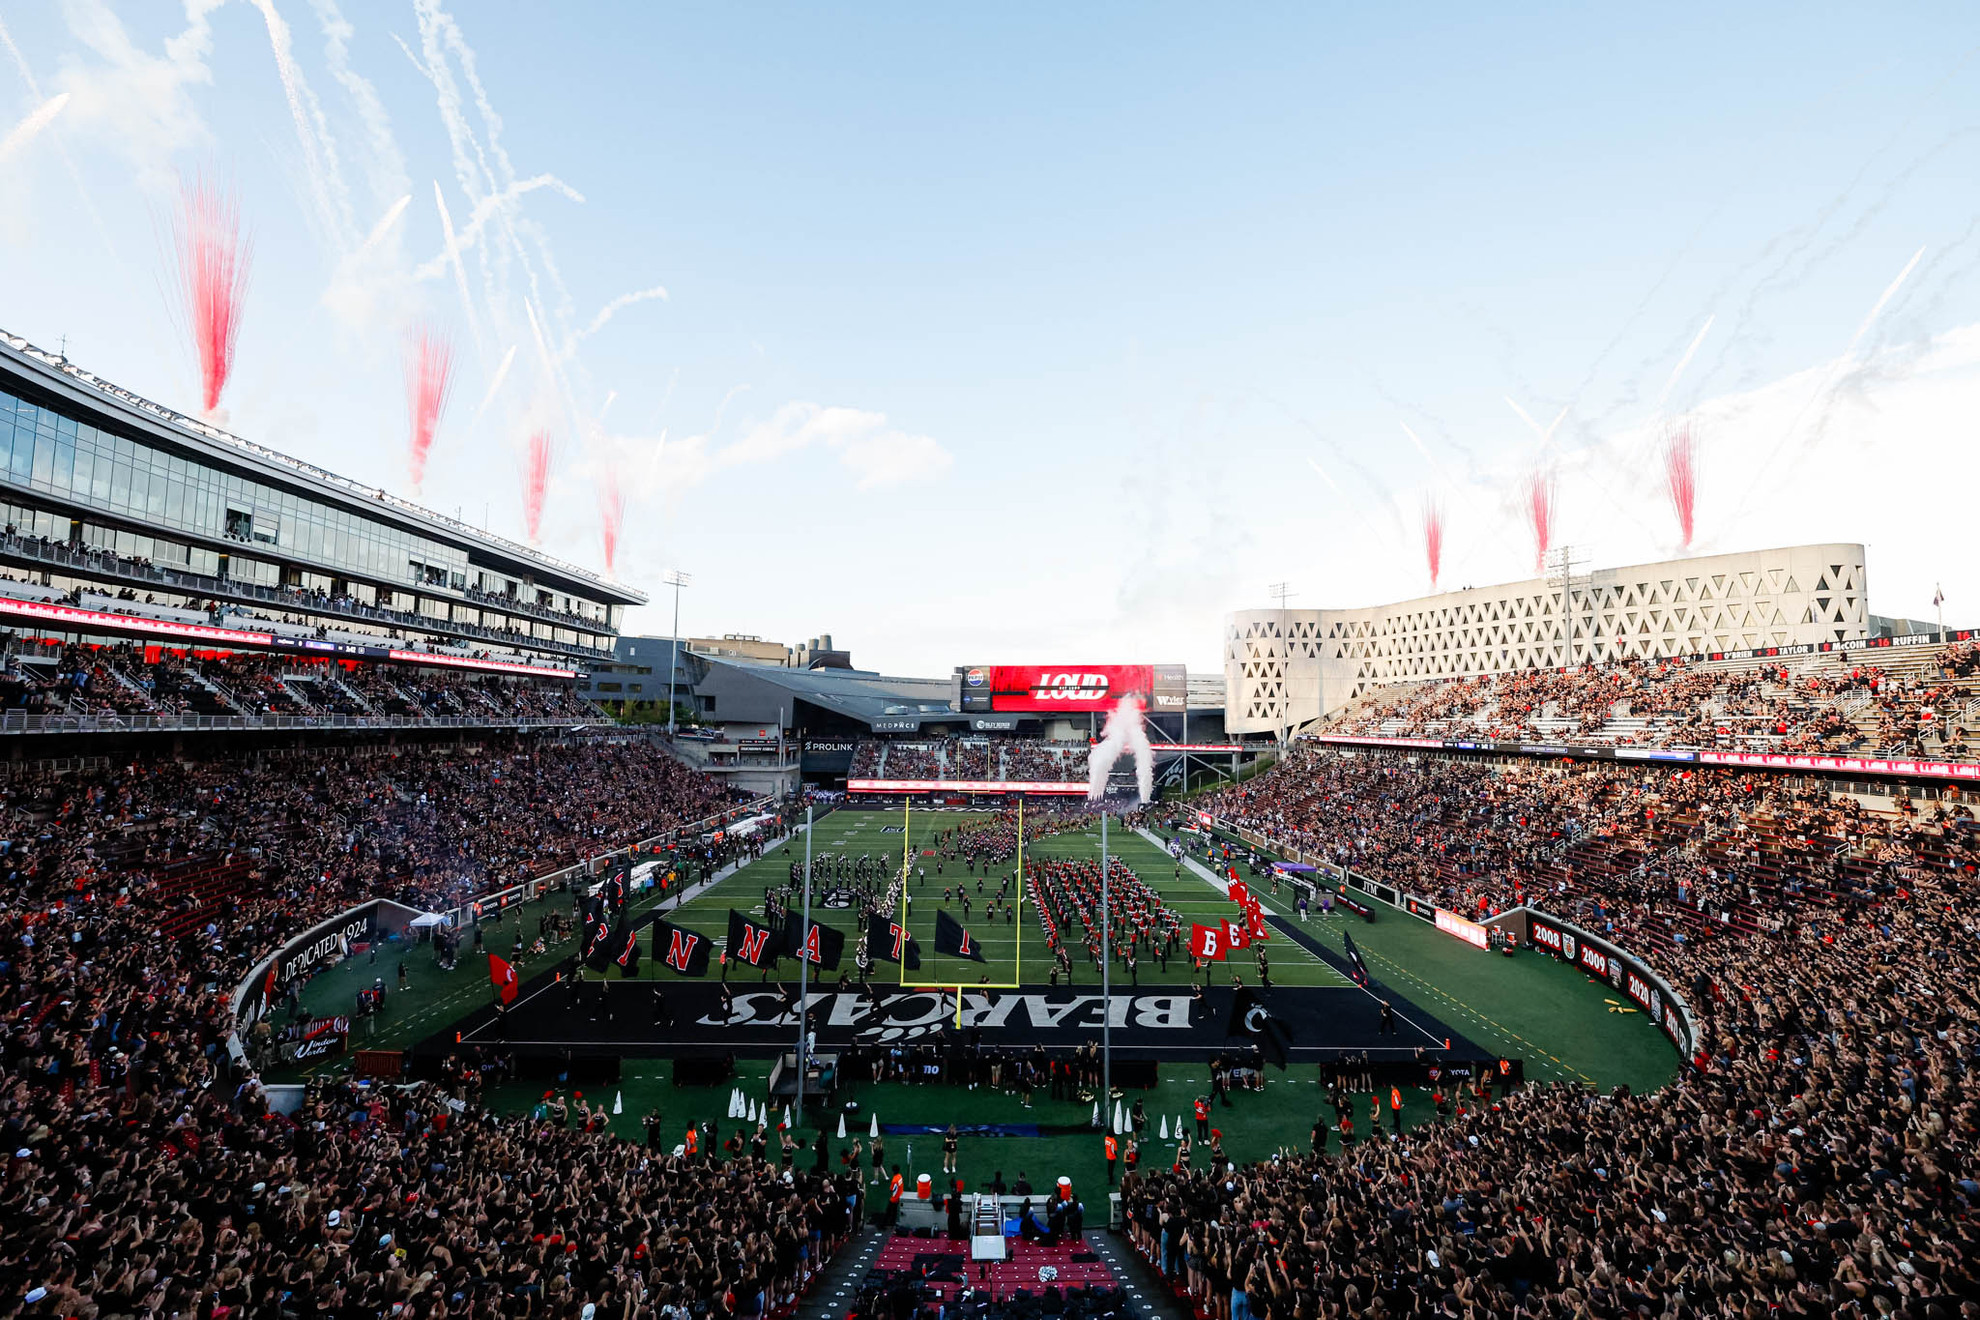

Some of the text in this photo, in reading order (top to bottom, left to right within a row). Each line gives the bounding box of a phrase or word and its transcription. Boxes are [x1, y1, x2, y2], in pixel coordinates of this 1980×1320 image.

[1724, 650, 1753, 659] O'BRIEN
[1779, 646, 1808, 655] TAYLOR
[1832, 640, 1867, 651] McCOIN
[1892, 634, 1930, 646] RUFFIN
[1035, 673, 1109, 700] LOUD
[812, 743, 853, 751] PROLINK
[1362, 880, 1378, 896] JTM
[482, 901, 498, 911] TOYOTA
[1417, 906, 1431, 917] TOYOTA
[1203, 930, 1218, 957] B
[1534, 924, 1561, 948] 2008
[665, 928, 698, 971] N
[737, 923, 769, 966] N
[797, 924, 821, 964] A
[889, 922, 911, 960] T
[1581, 946, 1606, 974] 2009
[1629, 974, 1650, 1006] 2020
